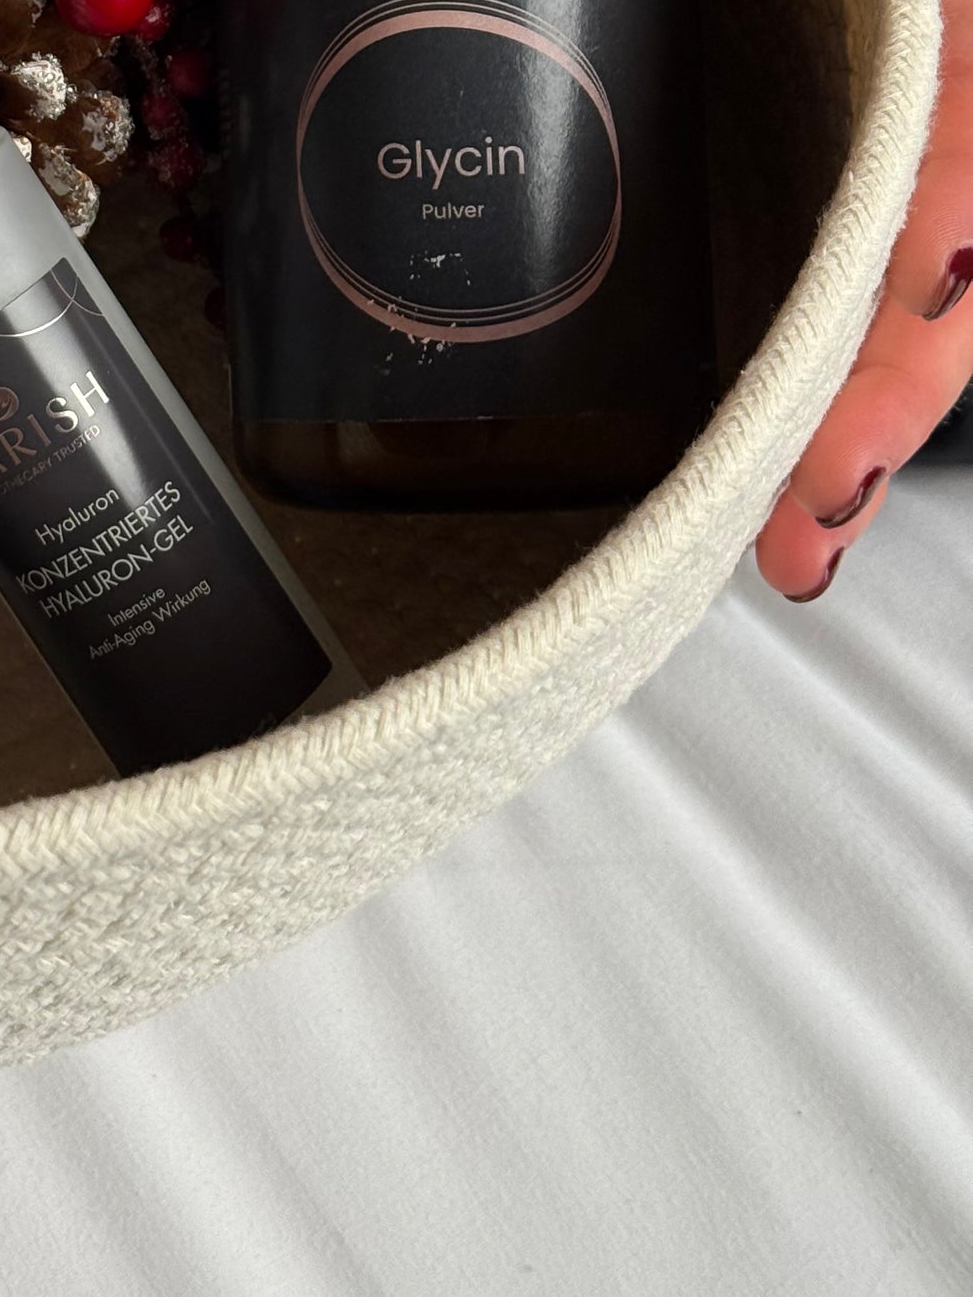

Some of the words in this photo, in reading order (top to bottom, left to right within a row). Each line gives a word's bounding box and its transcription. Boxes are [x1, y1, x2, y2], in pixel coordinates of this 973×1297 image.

[377, 136, 525, 189] Glycin
[422, 202, 485, 220] Pulver
[15, 480, 182, 595] KONZENTRIERTES
[34, 488, 121, 546] Hyaluron
[38, 514, 194, 619] HYALURON-GEL
[88, 619, 156, 660] Anti-Aging
[151, 578, 212, 622] Wirkung
[107, 587, 166, 627] Intensive
